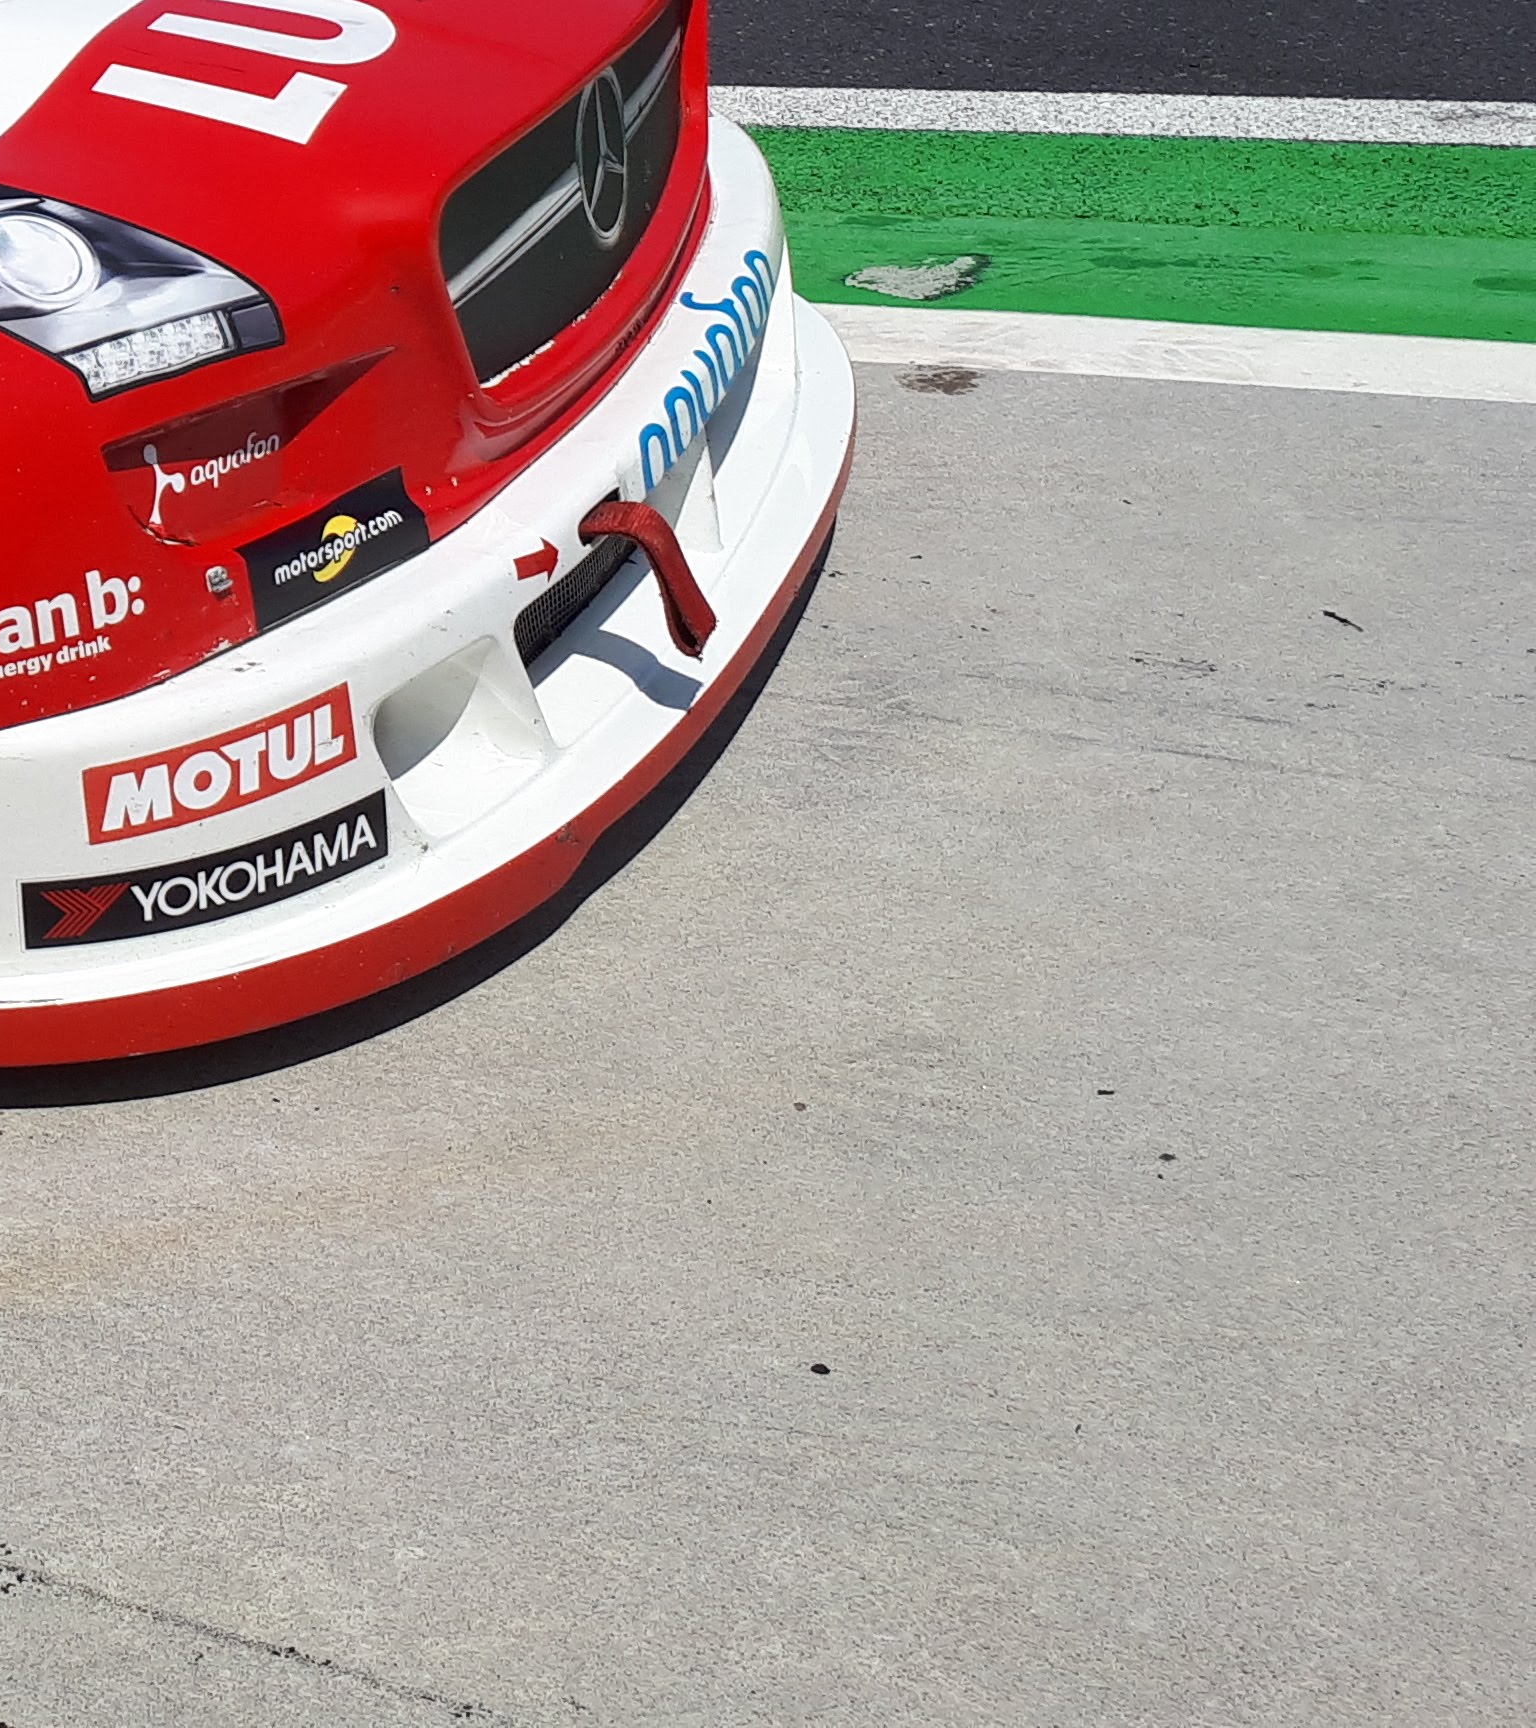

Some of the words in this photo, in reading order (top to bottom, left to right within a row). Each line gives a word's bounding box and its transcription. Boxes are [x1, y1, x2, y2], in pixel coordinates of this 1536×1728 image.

[190, 432, 280, 488] aquafon
[274, 510, 403, 585] motorsport.com
[55, 635, 112, 665] drink
[101, 703, 345, 833] MOTUL
[130, 813, 378, 923] YOKOHAMA
